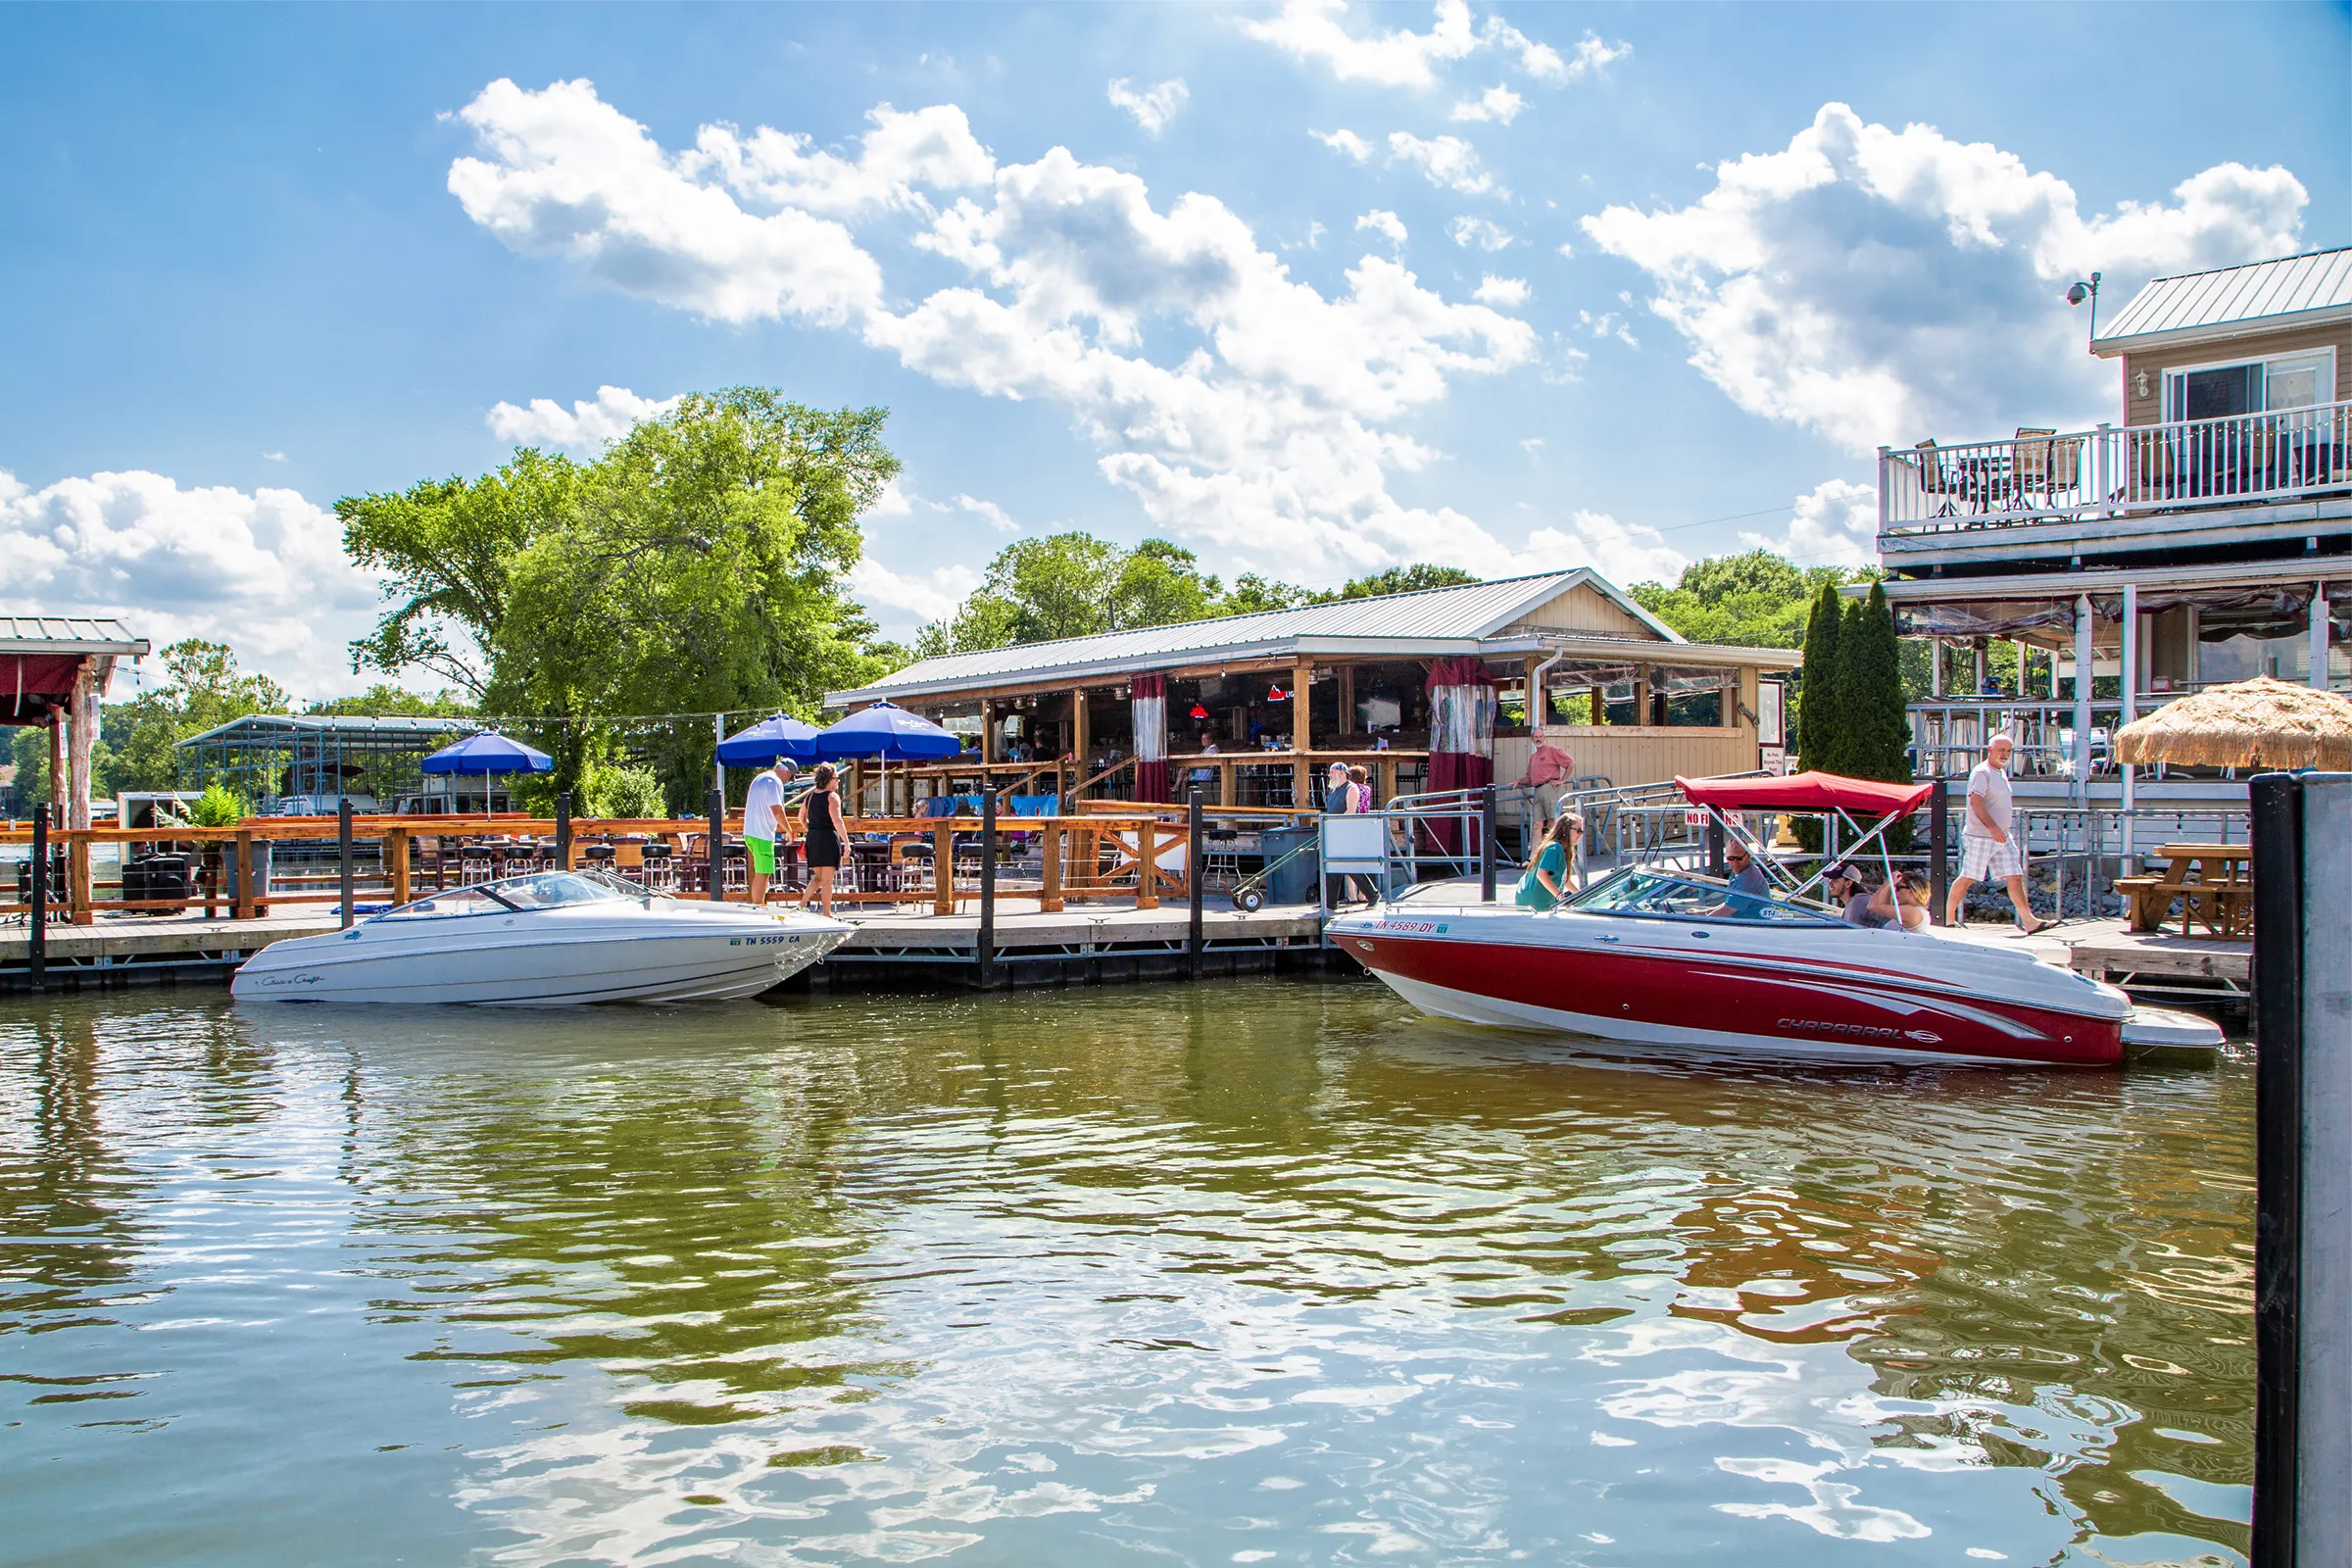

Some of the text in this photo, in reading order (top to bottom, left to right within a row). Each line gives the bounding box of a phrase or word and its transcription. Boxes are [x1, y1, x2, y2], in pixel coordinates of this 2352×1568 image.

[1687, 812, 1698, 824] NO
[1375, 920, 1436, 933] TN 4589 DY
[745, 935, 800, 946] TN 5559 CA
[1776, 1017, 1903, 1040] CHAPARRAL
